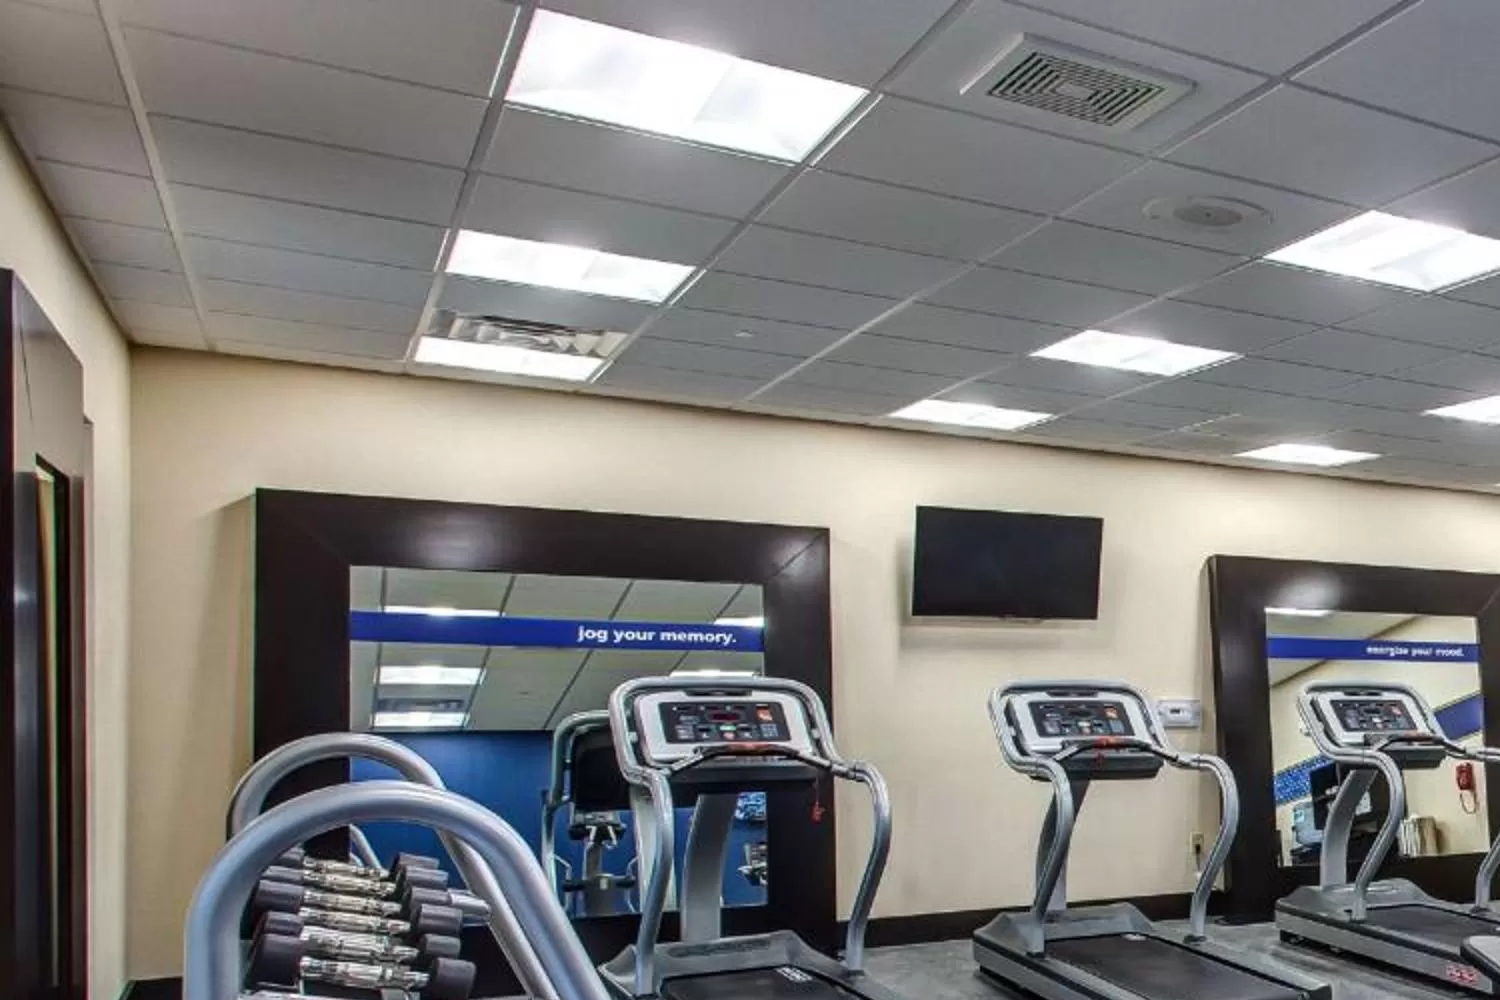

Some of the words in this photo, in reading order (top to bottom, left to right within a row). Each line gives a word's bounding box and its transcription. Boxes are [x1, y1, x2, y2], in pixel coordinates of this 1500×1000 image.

[577, 625, 608, 643] jog
[613, 629, 656, 643] your
[660, 630, 737, 646] memory.
